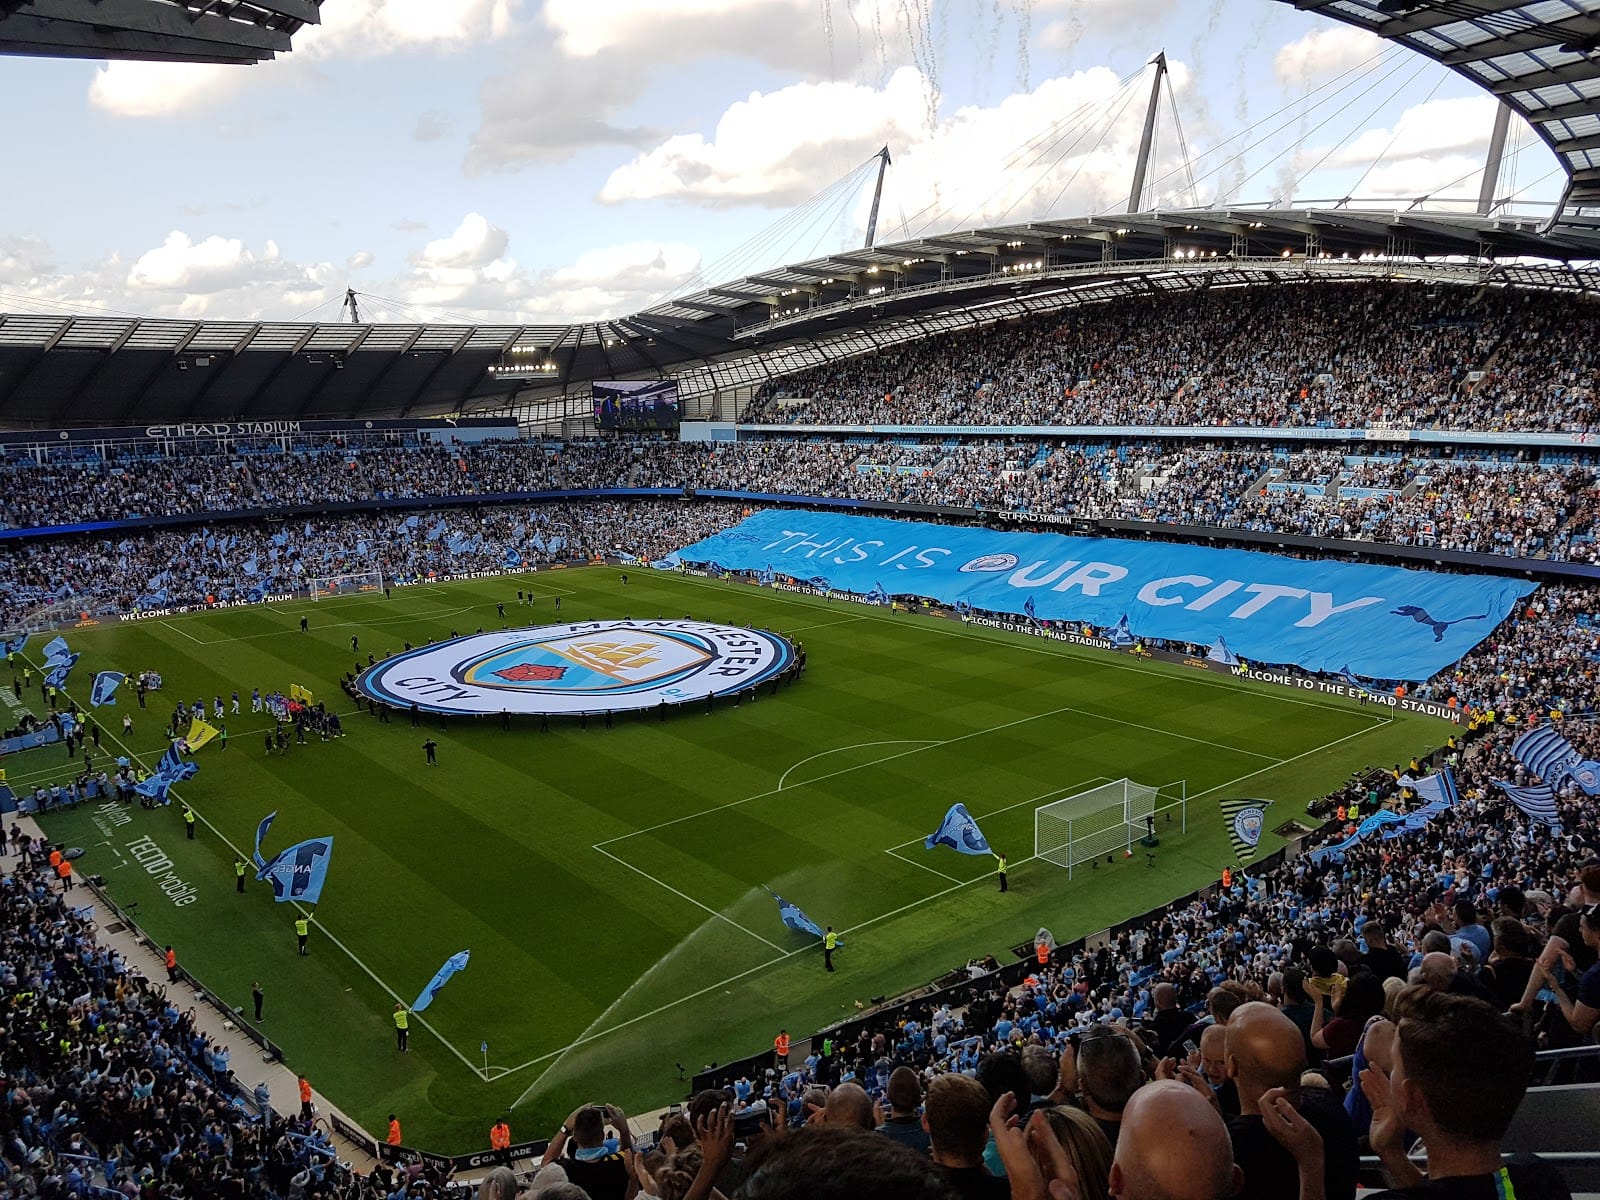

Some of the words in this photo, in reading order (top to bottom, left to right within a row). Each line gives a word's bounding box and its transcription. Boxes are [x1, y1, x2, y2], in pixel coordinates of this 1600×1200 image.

[146, 424, 230, 437] ETIHAD
[237, 422, 300, 434] STADIUM
[998, 511, 1039, 521] ETIHAD
[1040, 514, 1071, 525] STADIUM
[471, 570, 501, 579] ETIHAD
[762, 530, 885, 565] THIS
[878, 546, 952, 570] IS
[1137, 574, 1386, 628] CITY
[812, 588, 825, 597] THE
[119, 608, 171, 622] WELCOME
[1002, 622, 1014, 632] TO
[1016, 624, 1033, 635] THE
[1069, 634, 1111, 650] STADIUM
[570, 621, 763, 678] MANCHESTER
[395, 677, 482, 702] CITY
[1295, 677, 1314, 690] TO
[1318, 682, 1345, 695] THE
[1348, 688, 1397, 706] ETHAD
[1401, 699, 1461, 723] STADIUM
[125, 834, 175, 875] TECNO
